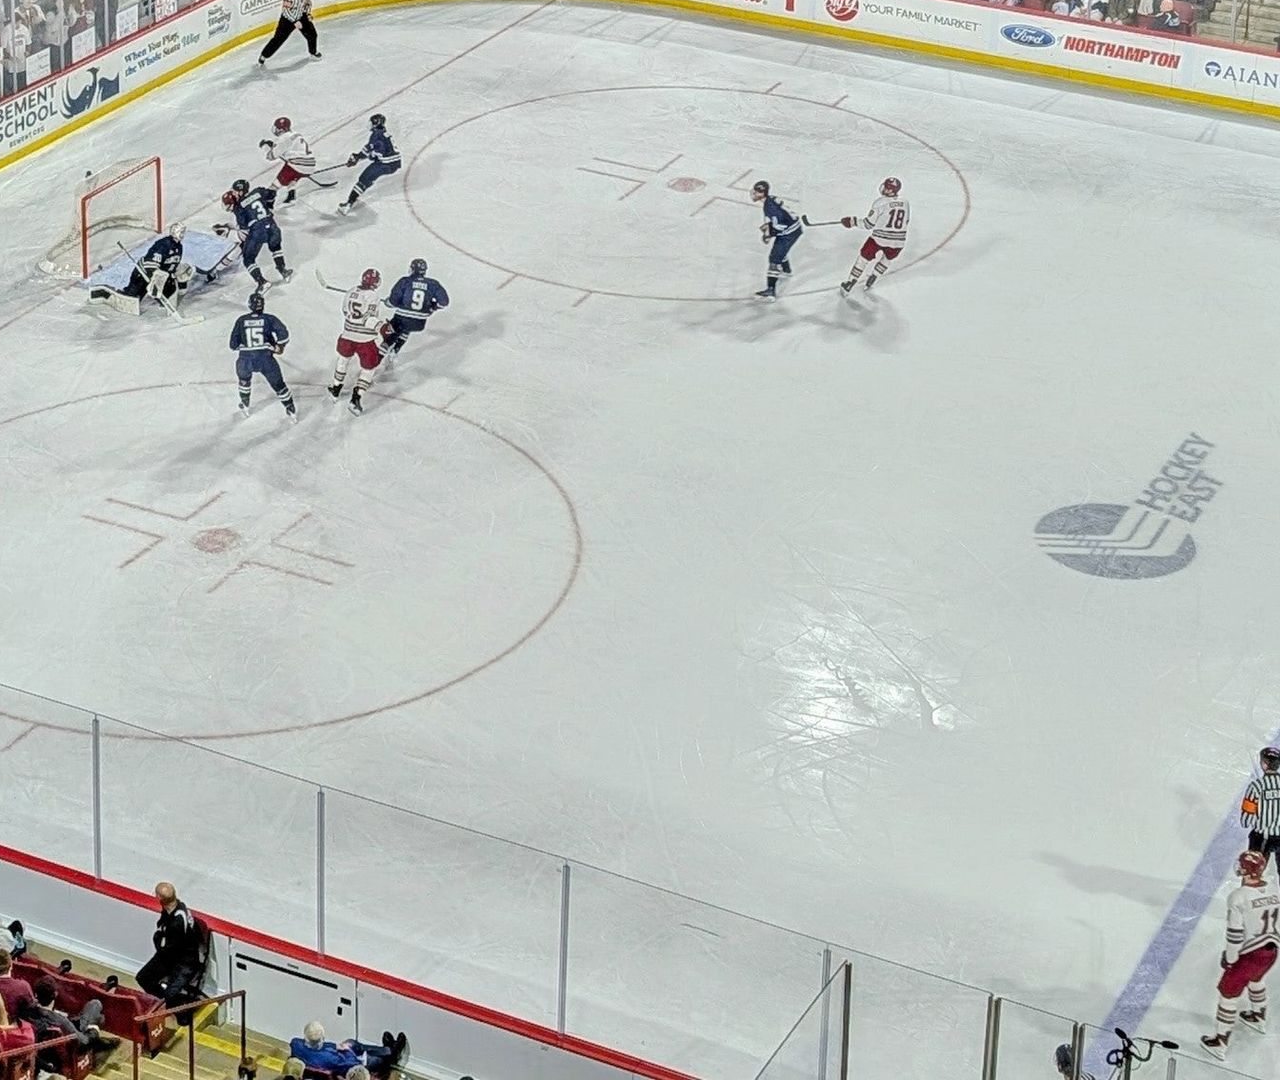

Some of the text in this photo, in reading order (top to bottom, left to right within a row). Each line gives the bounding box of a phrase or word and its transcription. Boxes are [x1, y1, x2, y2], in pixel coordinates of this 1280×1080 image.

[863, 2, 979, 32] YOUR FAMILY MARKET
[1011, 27, 1044, 44] Ford
[124, 47, 147, 63] When
[148, 40, 161, 53] You
[125, 32, 201, 77] the Whole State Way
[1063, 35, 1181, 69] NORTHAMPTON
[252, 200, 266, 220] 3
[885, 209, 905, 229] 18
[411, 289, 425, 310] 9
[245, 327, 264, 348] 15
[1135, 432, 1216, 512] HOCKEY
[1169, 470, 1224, 523] EAST
[1261, 908, 1280, 935] 11
